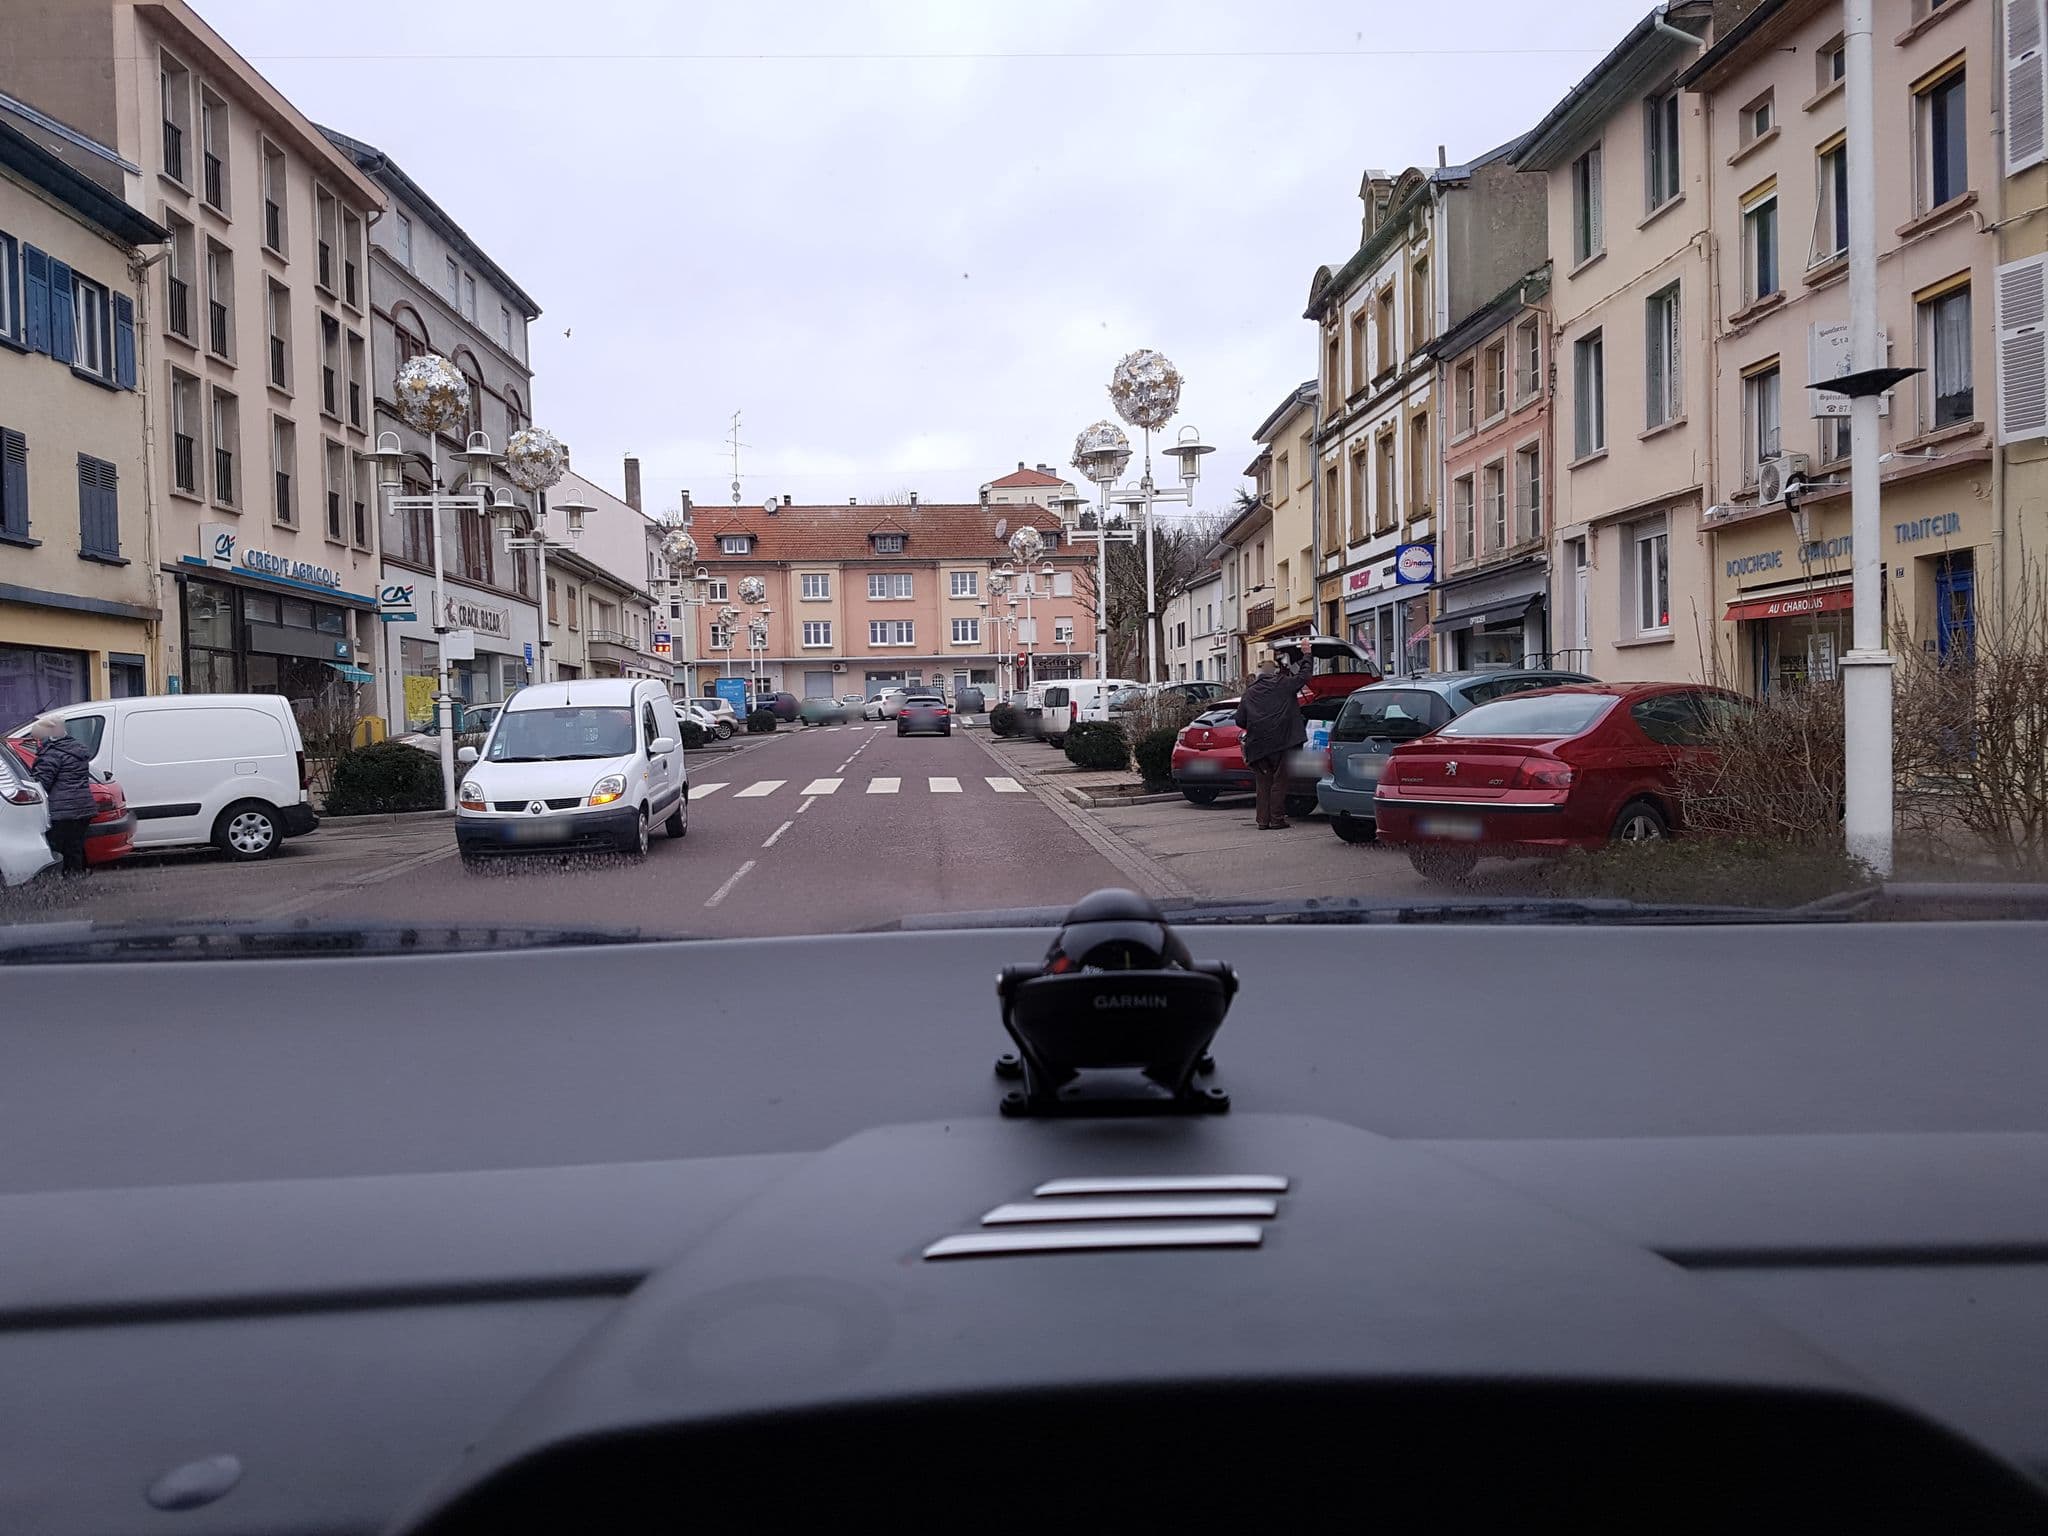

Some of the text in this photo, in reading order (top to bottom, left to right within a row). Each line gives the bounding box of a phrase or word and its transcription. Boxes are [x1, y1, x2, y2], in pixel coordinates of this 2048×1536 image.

[1894, 511, 1961, 544] TRAITEUR
[247, 549, 341, 587] CRÉDIT AGRICOLE
[1726, 535, 1853, 577] BOUCHERIE CHARCUT
[459, 605, 501, 632] CRACK BAZAR
[1768, 602, 1780, 614] AU
[1093, 996, 1168, 1009] GARMIN
